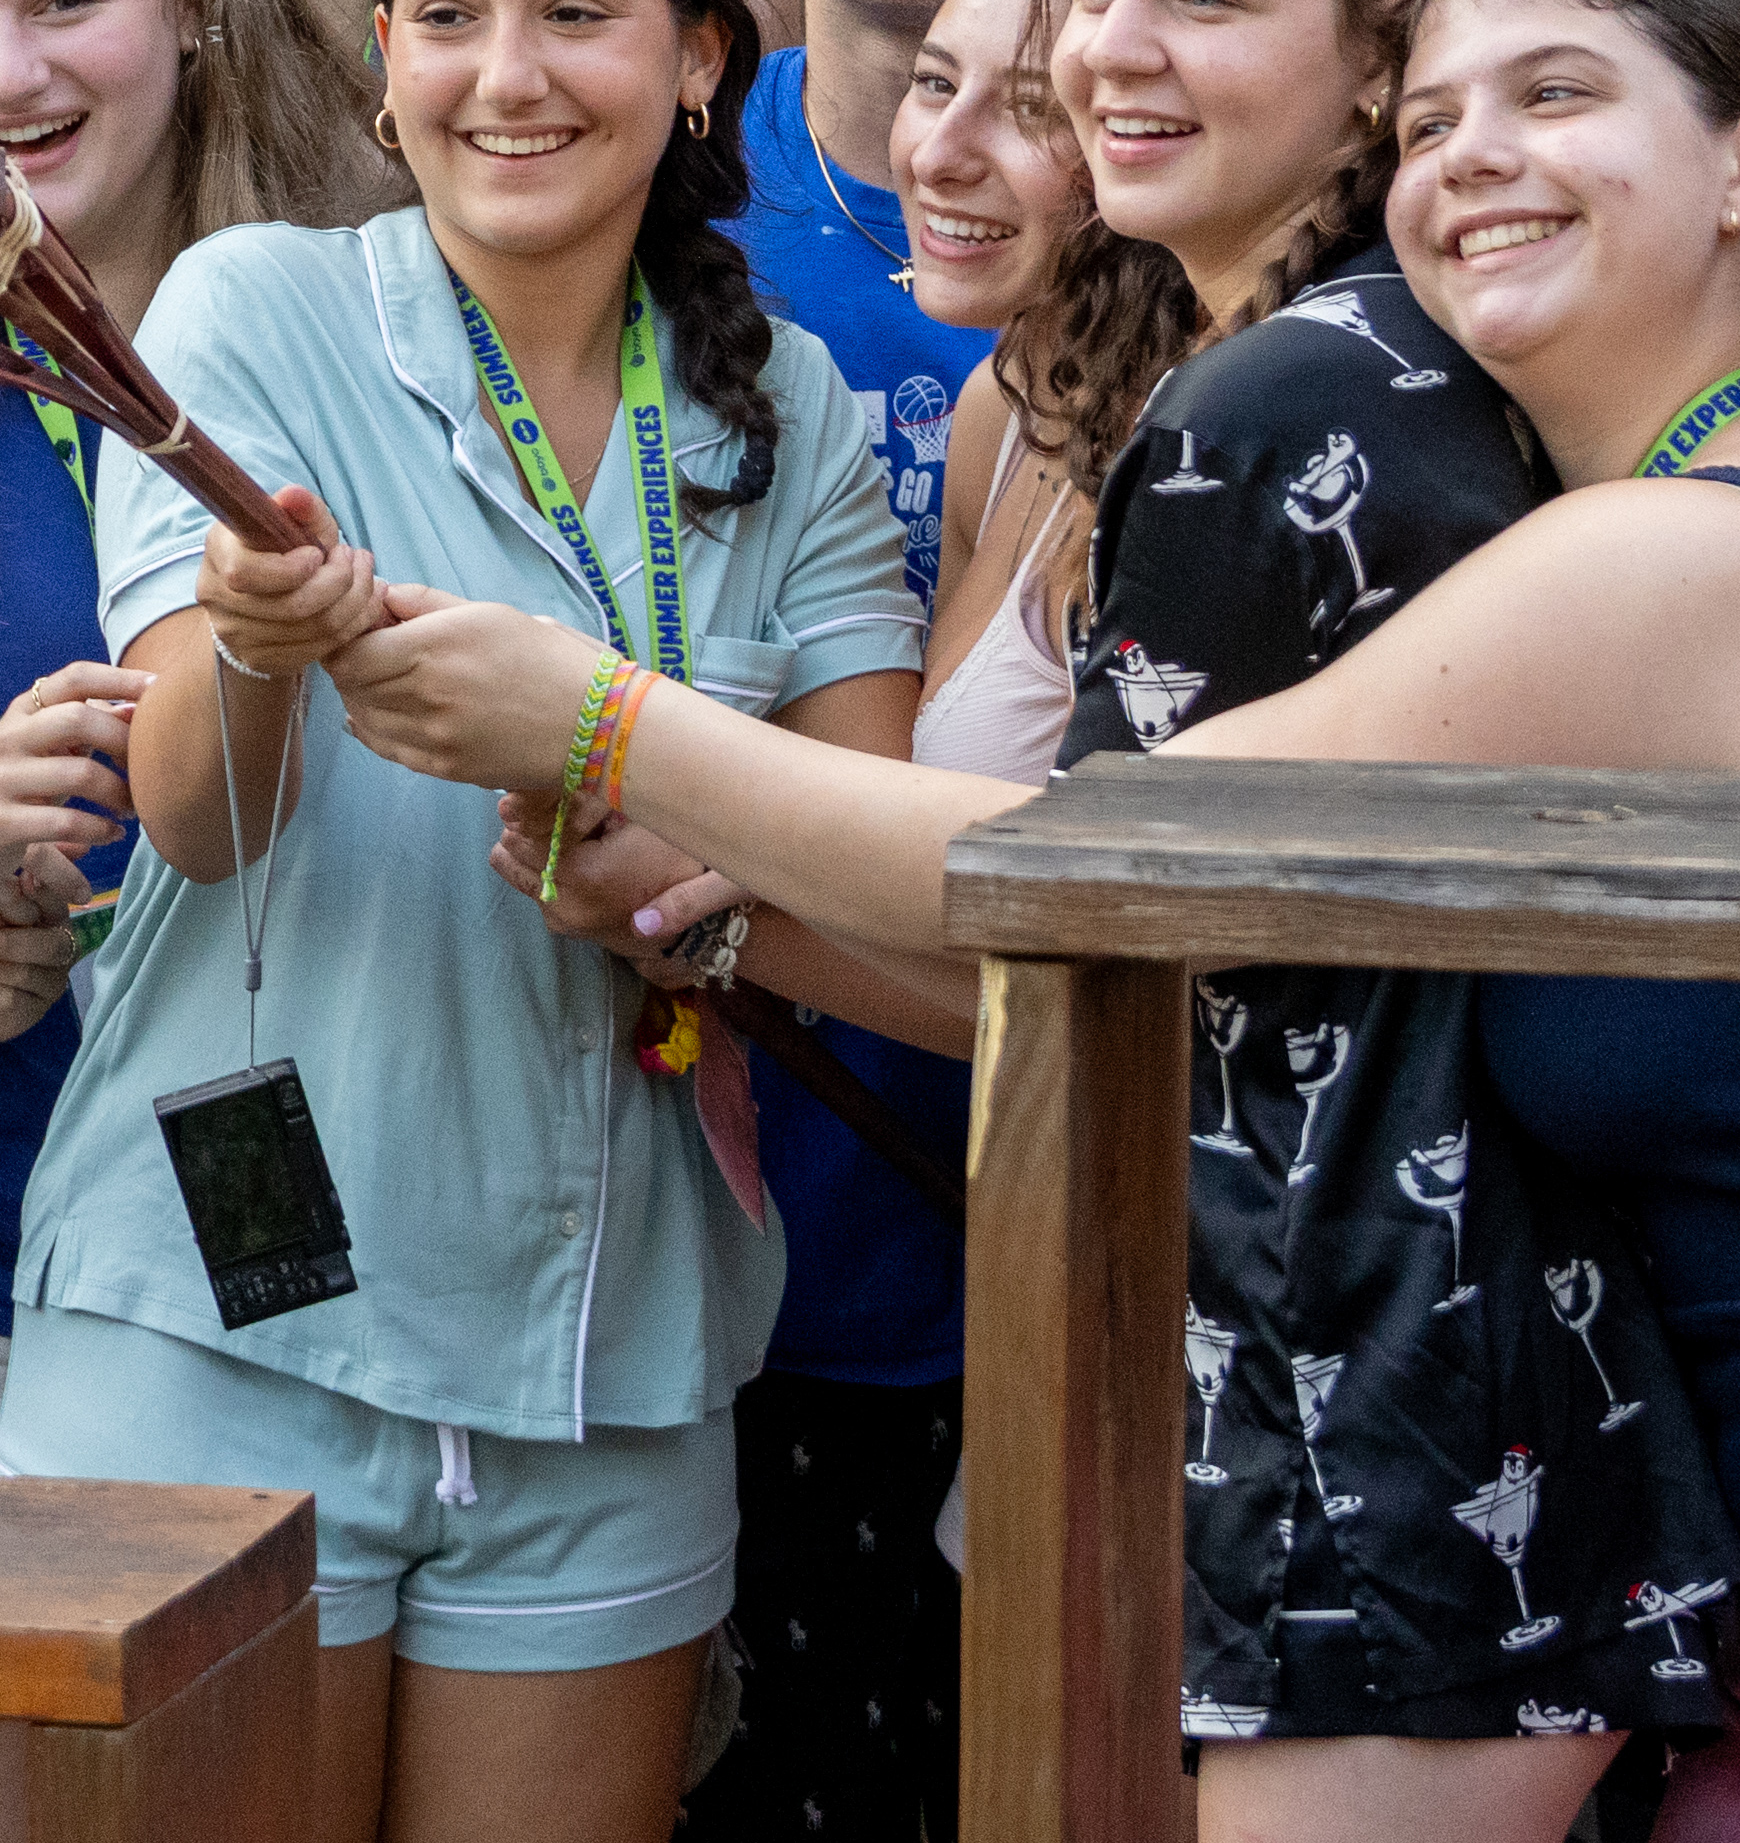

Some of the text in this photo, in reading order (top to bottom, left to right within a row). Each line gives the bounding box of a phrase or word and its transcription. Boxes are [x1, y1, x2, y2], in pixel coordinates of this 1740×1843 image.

[632, 404, 687, 681] SUMMER EXPERIENCES
[896, 467, 933, 514] GO
